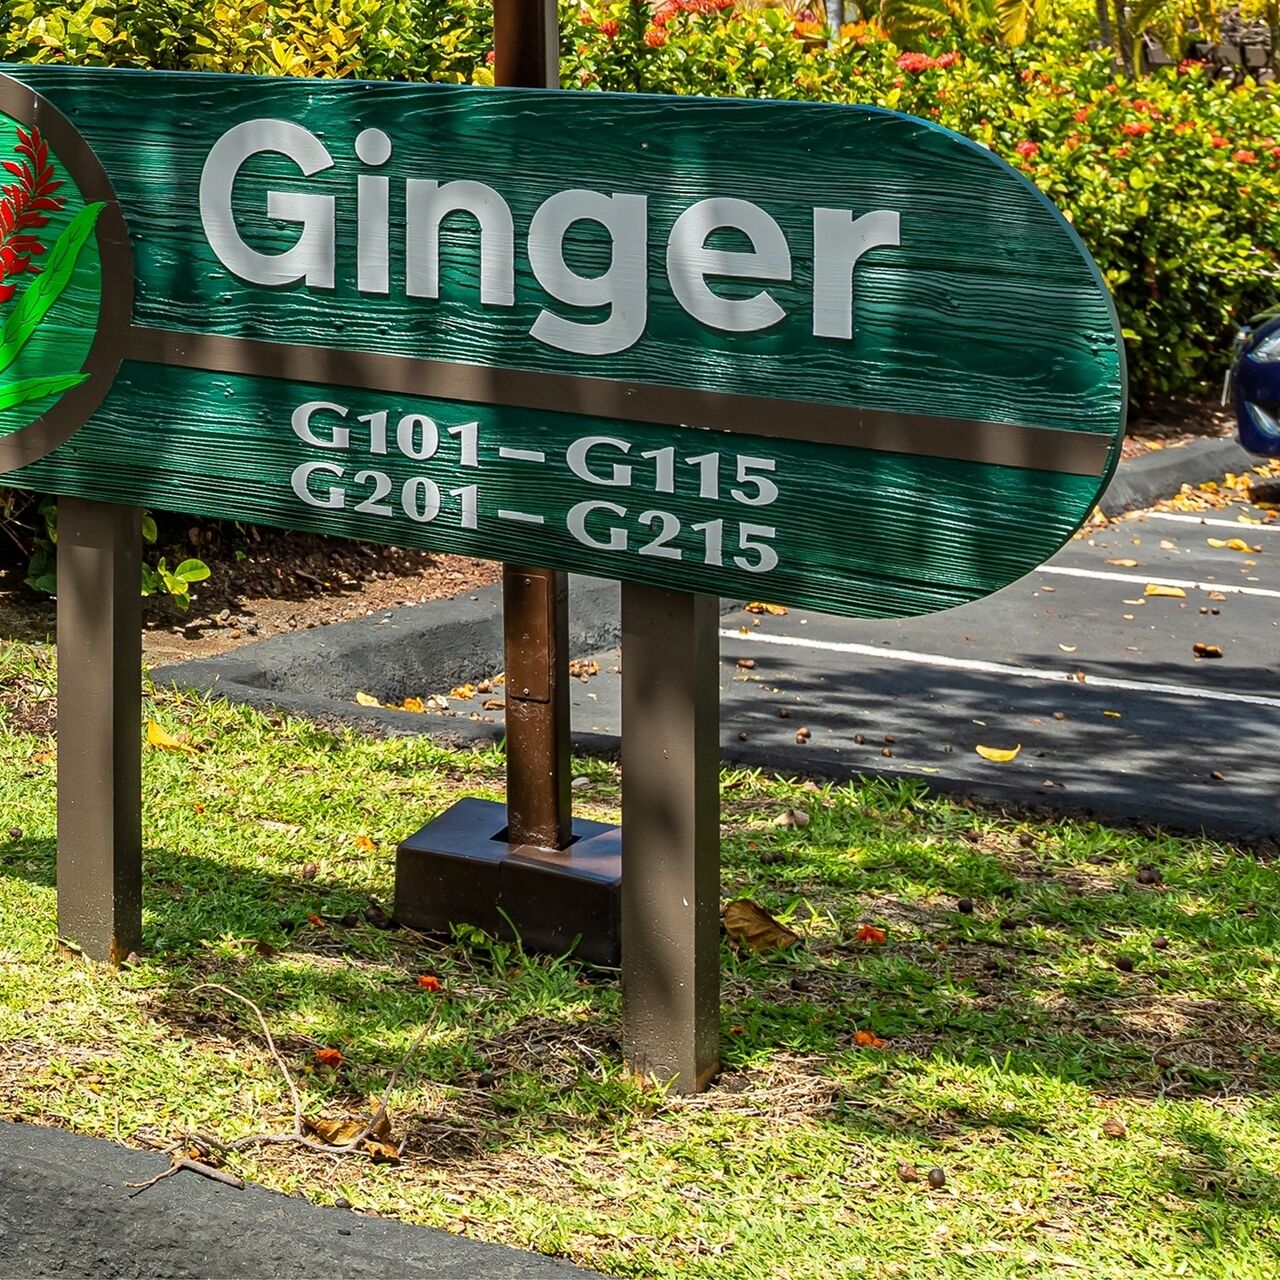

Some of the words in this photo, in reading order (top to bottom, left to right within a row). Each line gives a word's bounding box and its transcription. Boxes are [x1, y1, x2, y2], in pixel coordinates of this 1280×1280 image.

[198, 119, 901, 355] Ginger
[291, 401, 479, 468] G101
[566, 436, 779, 506] G115
[291, 461, 478, 530] G201
[566, 500, 779, 573] G215
